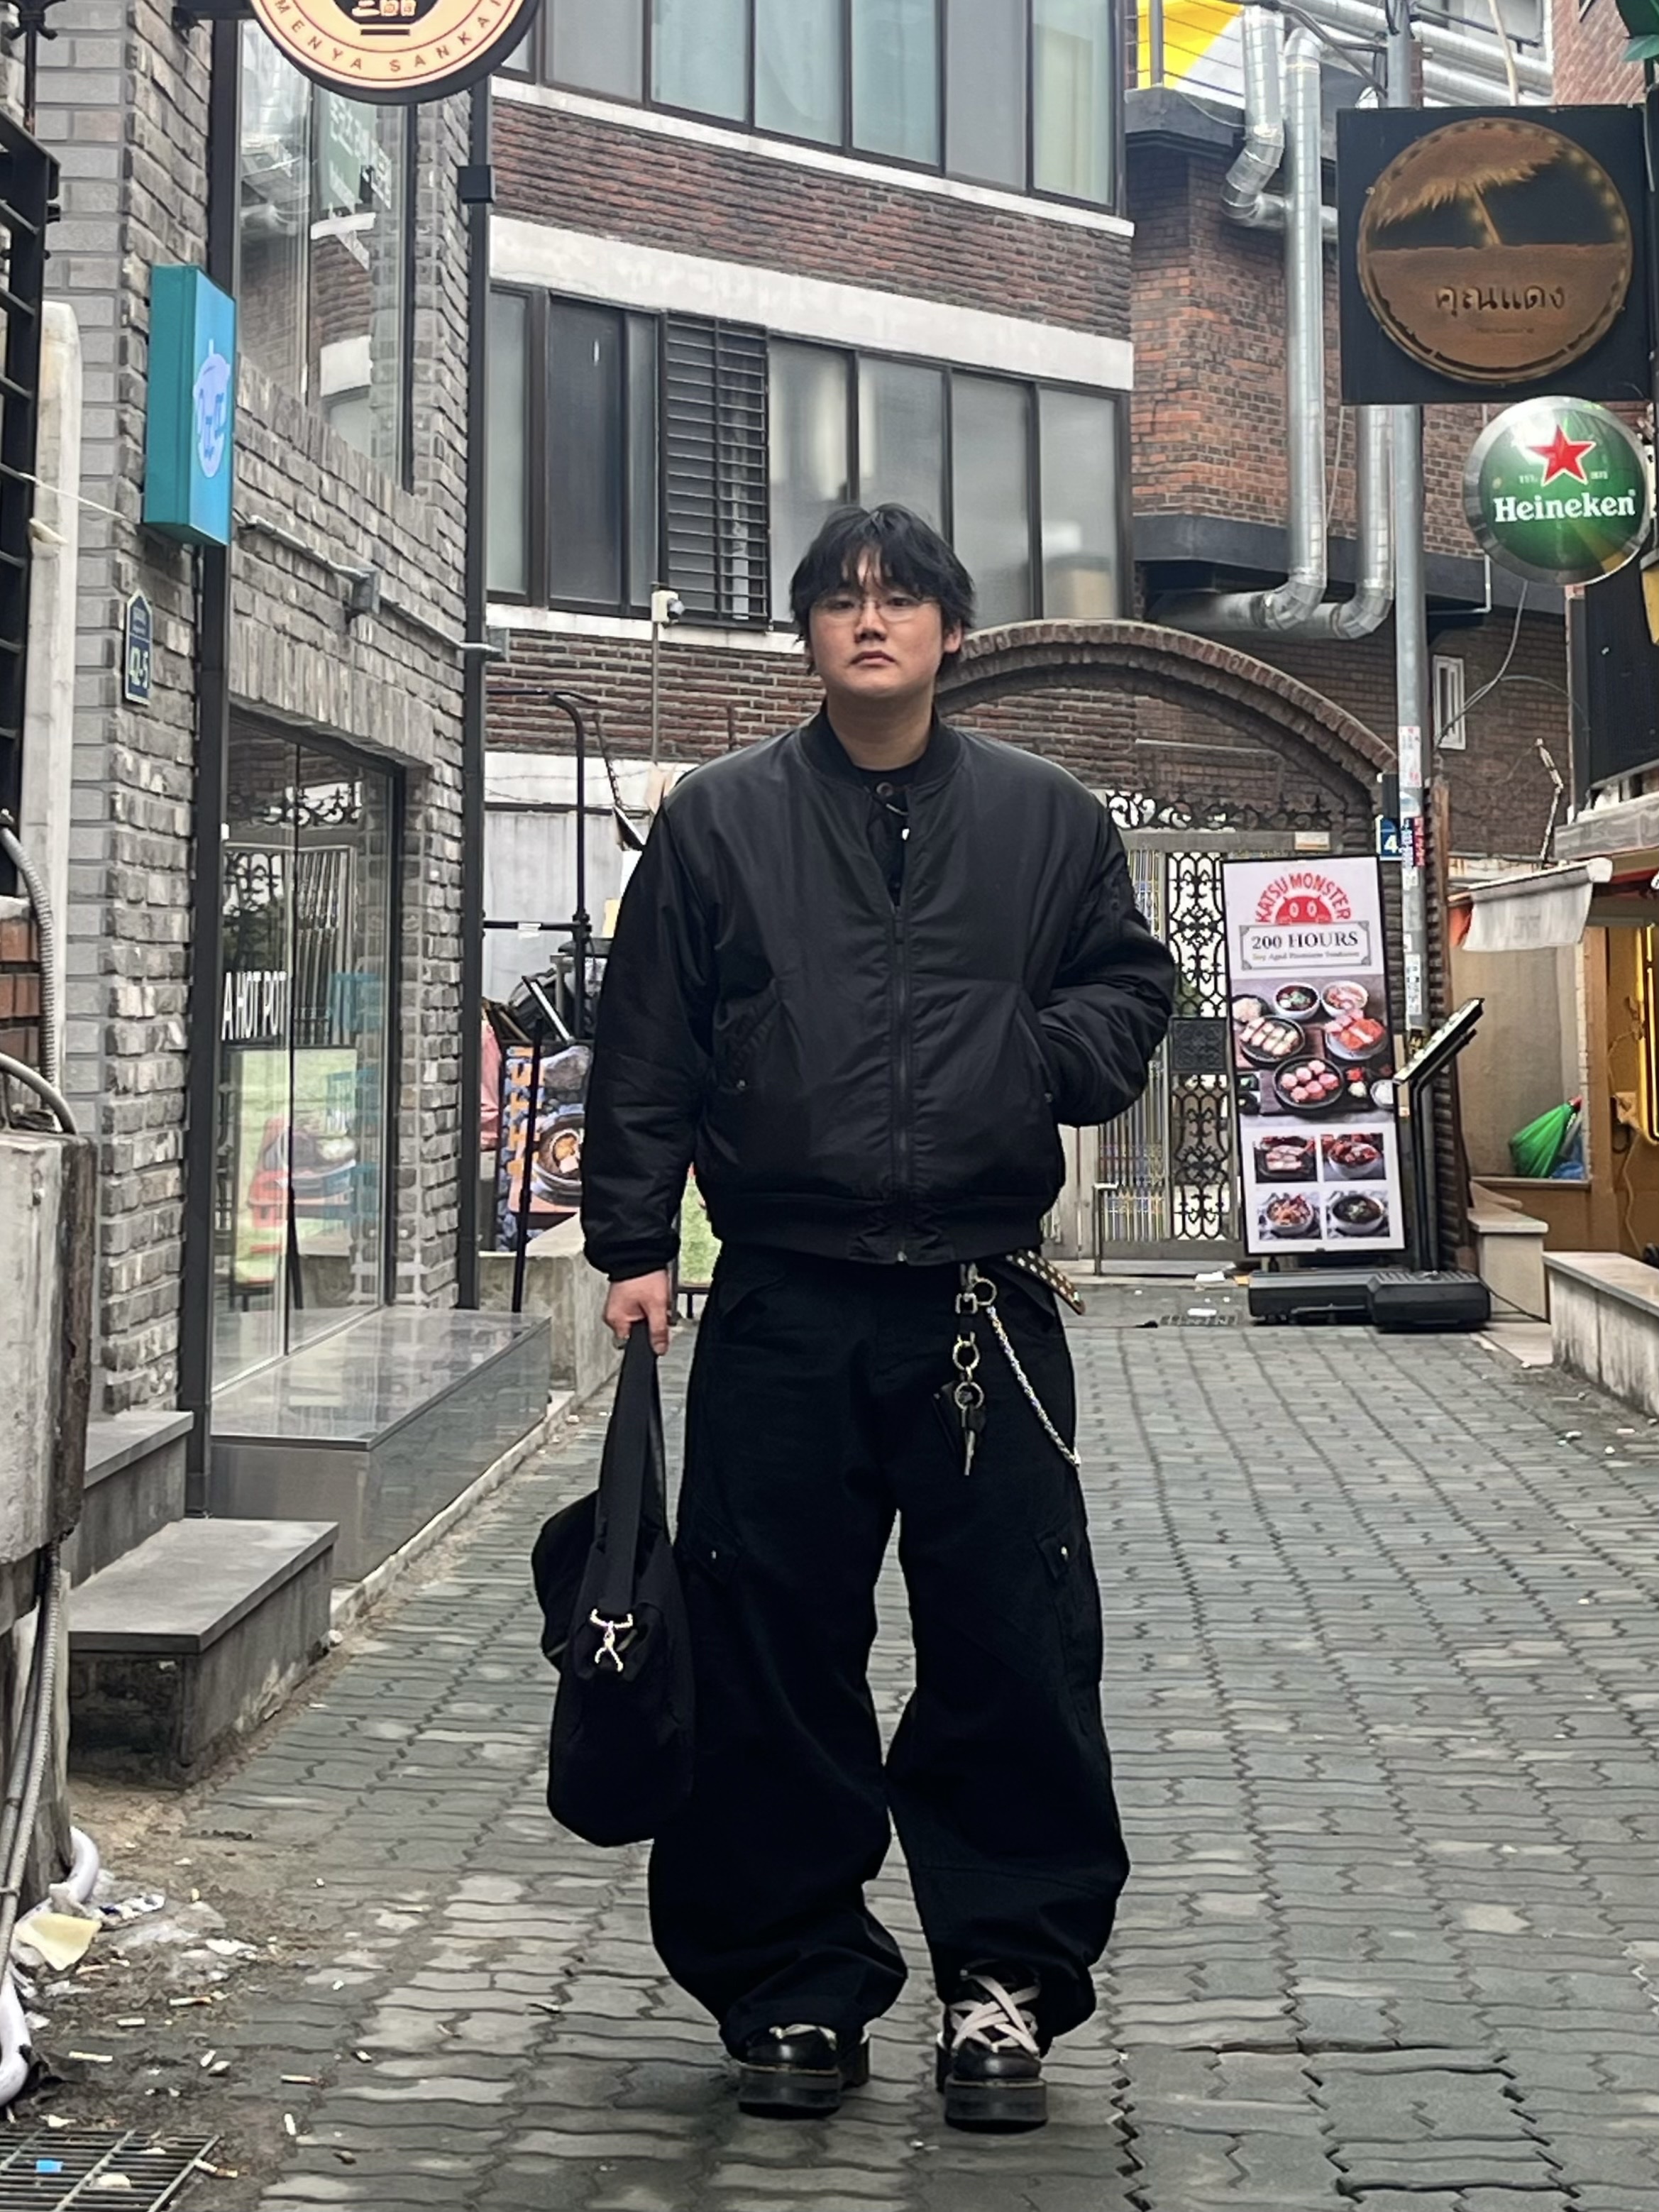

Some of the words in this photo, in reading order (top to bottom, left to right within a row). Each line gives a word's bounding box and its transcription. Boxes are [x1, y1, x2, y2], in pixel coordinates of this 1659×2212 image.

[277, 0, 363, 70] MENYA
[1493, 493, 1636, 522] Heineken
[1255, 876, 1288, 923] KATSU
[1289, 872, 1352, 920] MONSTER
[1251, 935, 1282, 950] 200
[1289, 931, 1358, 948] HOURS
[235, 970, 261, 1039] HOT
[262, 970, 287, 1037] POT
